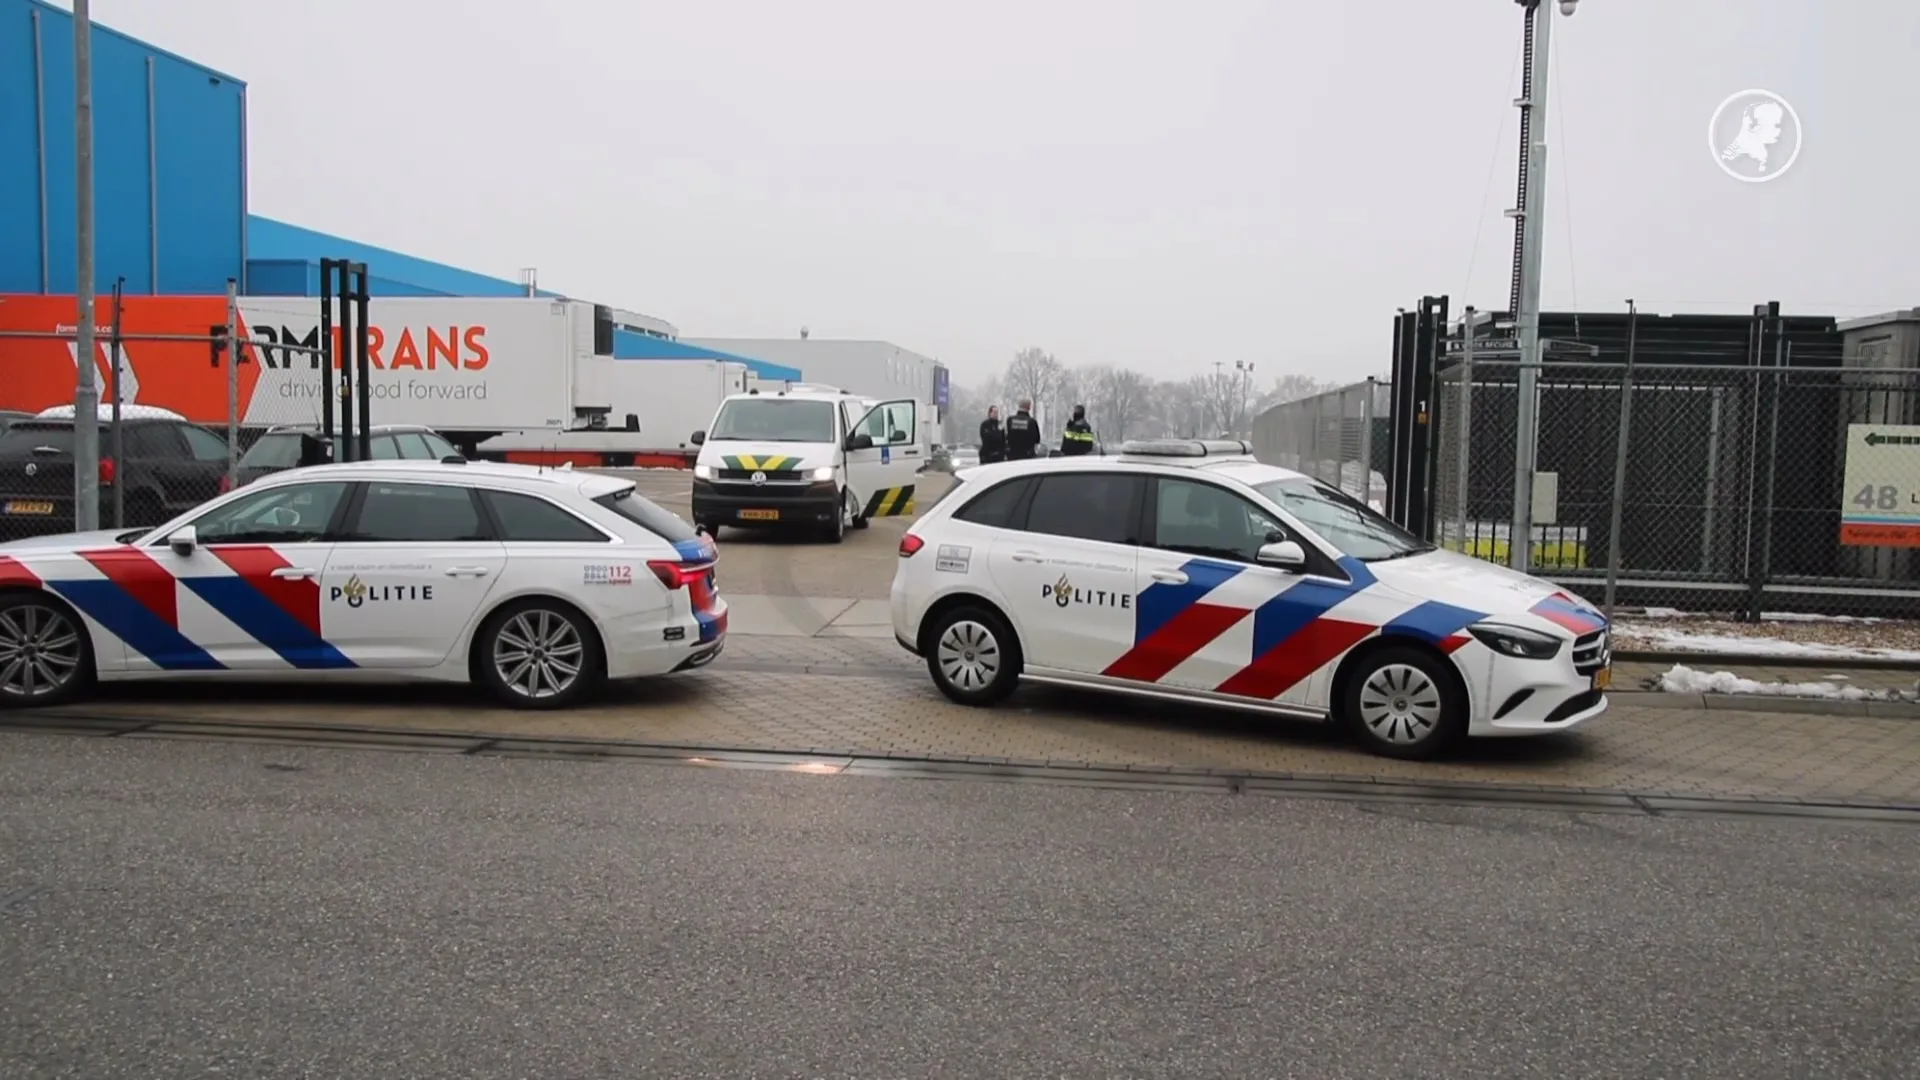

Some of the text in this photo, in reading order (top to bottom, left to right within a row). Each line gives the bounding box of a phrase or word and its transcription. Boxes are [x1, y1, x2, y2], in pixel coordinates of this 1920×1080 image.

[210, 325, 490, 371] FRMTRANS
[408, 380, 487, 400] forward
[1853, 484, 1898, 510] 48
[609, 566, 631, 578] 112
[331, 585, 433, 608] POLITIE
[1042, 583, 1131, 609] POLITIE
